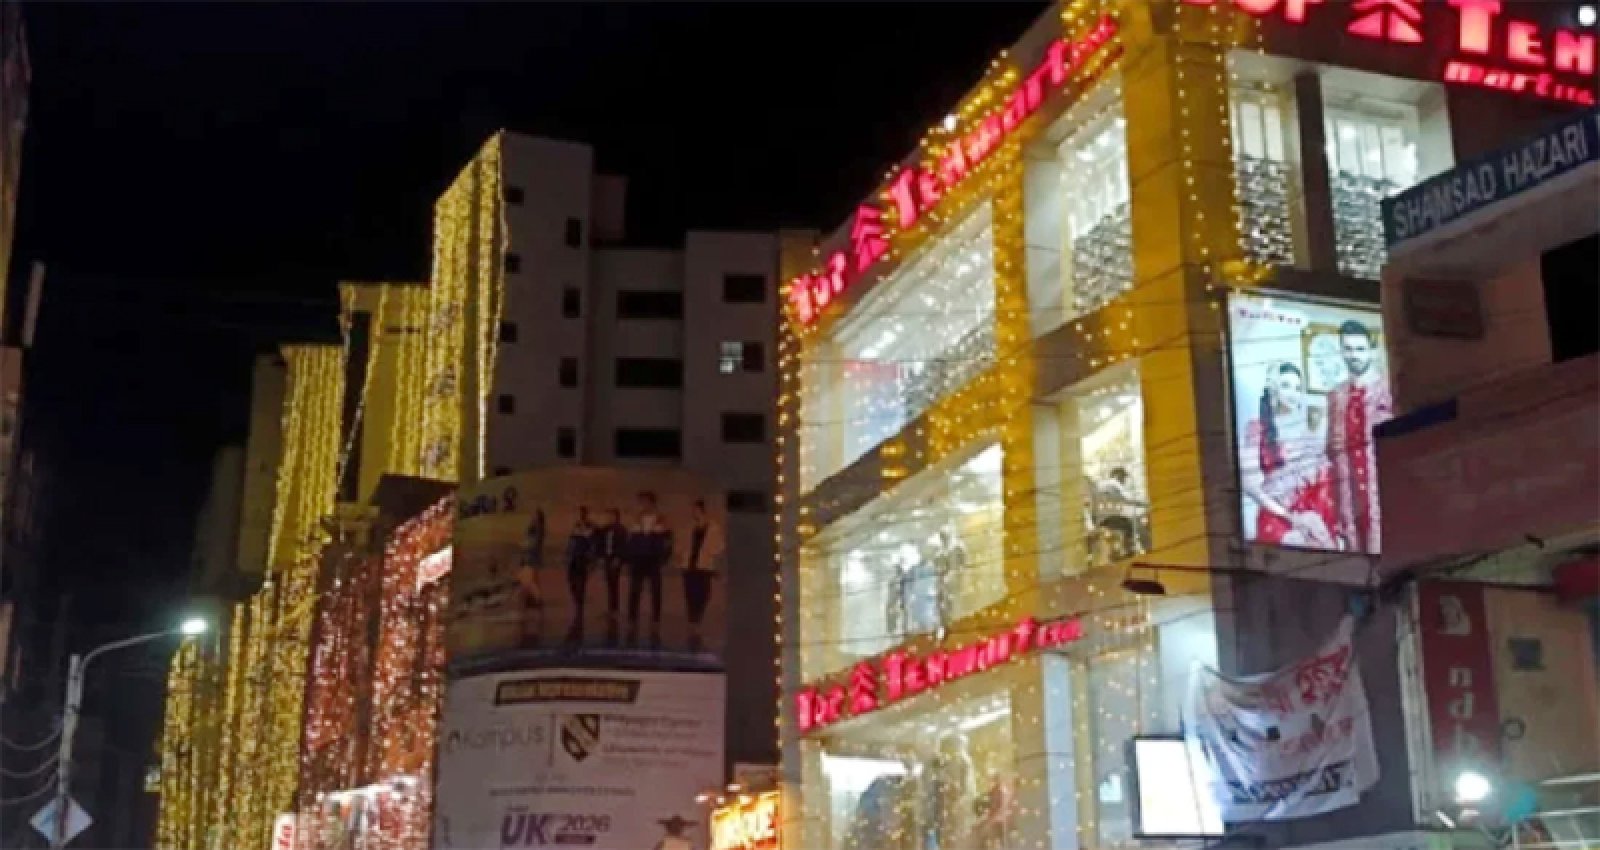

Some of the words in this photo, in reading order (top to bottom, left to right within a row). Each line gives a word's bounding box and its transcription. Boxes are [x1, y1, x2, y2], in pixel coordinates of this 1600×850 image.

[1393, 162, 1496, 238] SHAMSAD
[1503, 120, 1588, 193] HAZARI
[501, 813, 548, 845] UK
